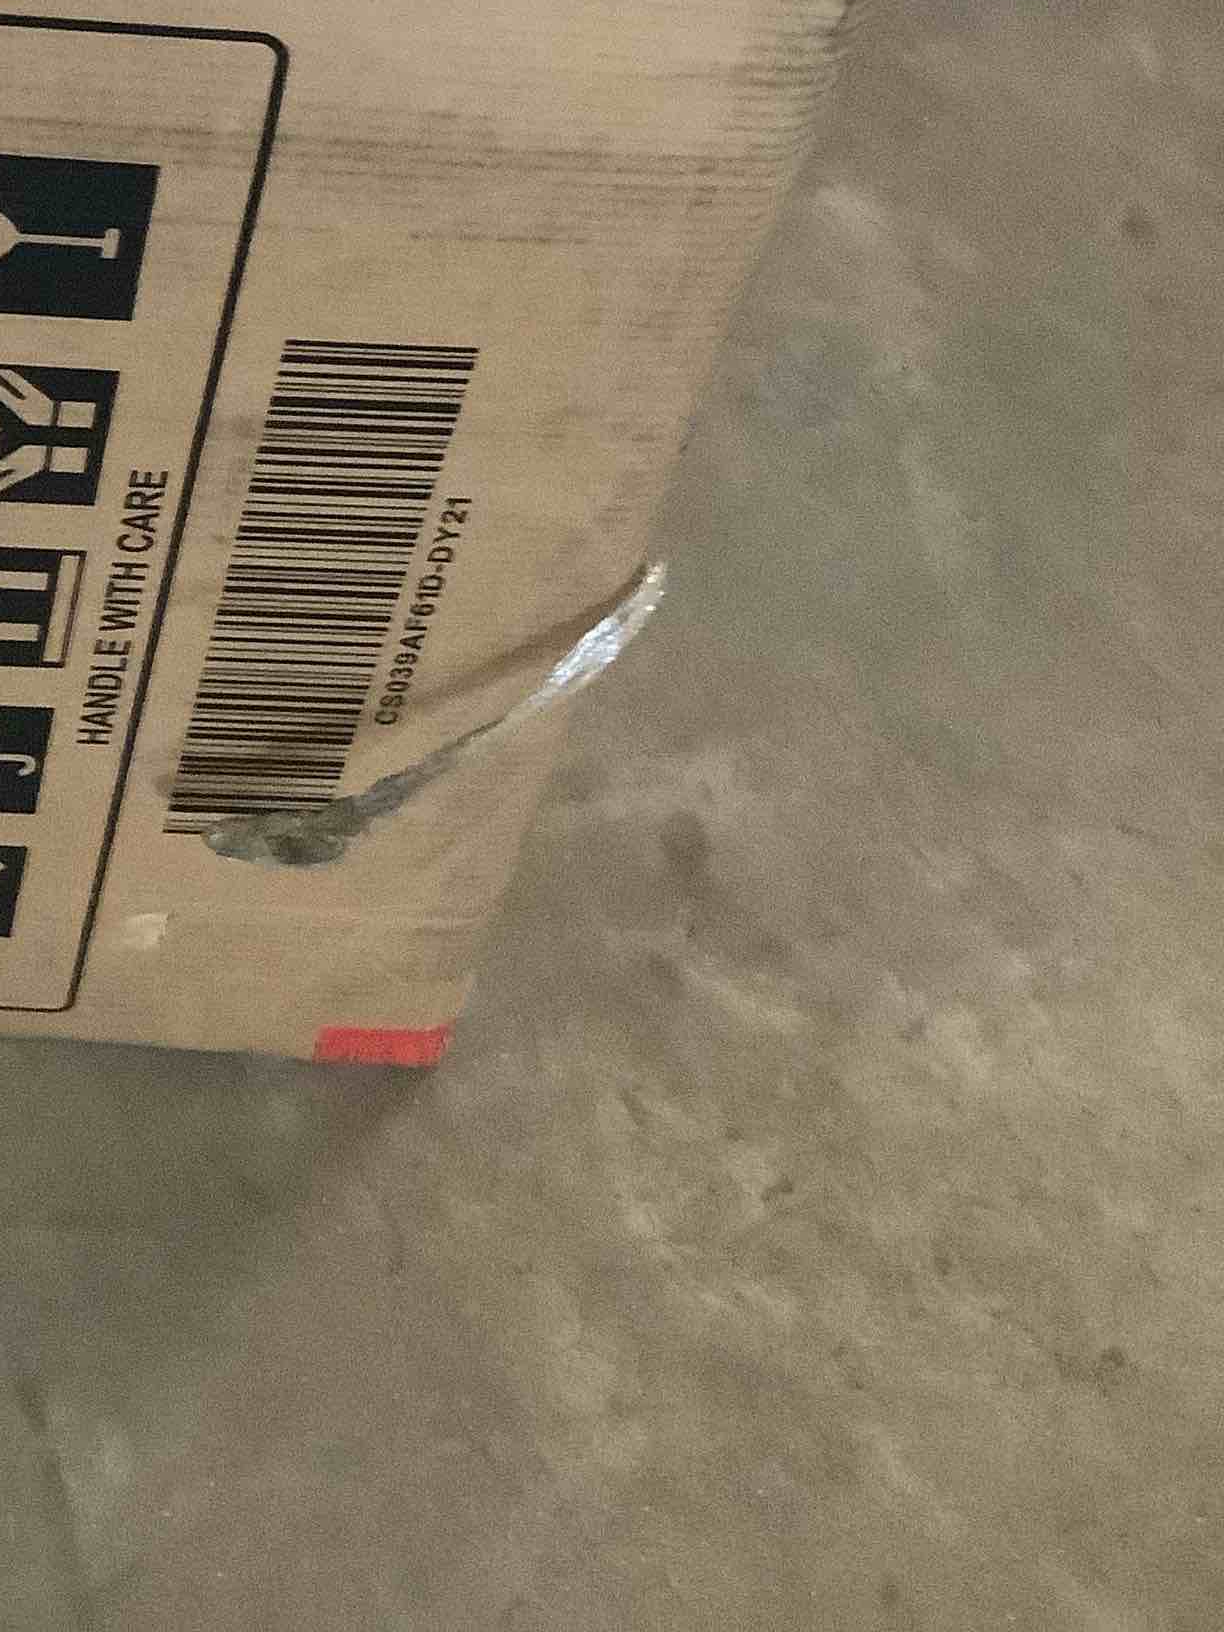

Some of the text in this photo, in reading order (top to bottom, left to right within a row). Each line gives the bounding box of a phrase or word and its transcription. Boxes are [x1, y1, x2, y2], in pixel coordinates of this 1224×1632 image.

[75, 469, 169, 745] HANDLE WITH CARE
[372, 497, 473, 726] CS039AF61D-DY21
